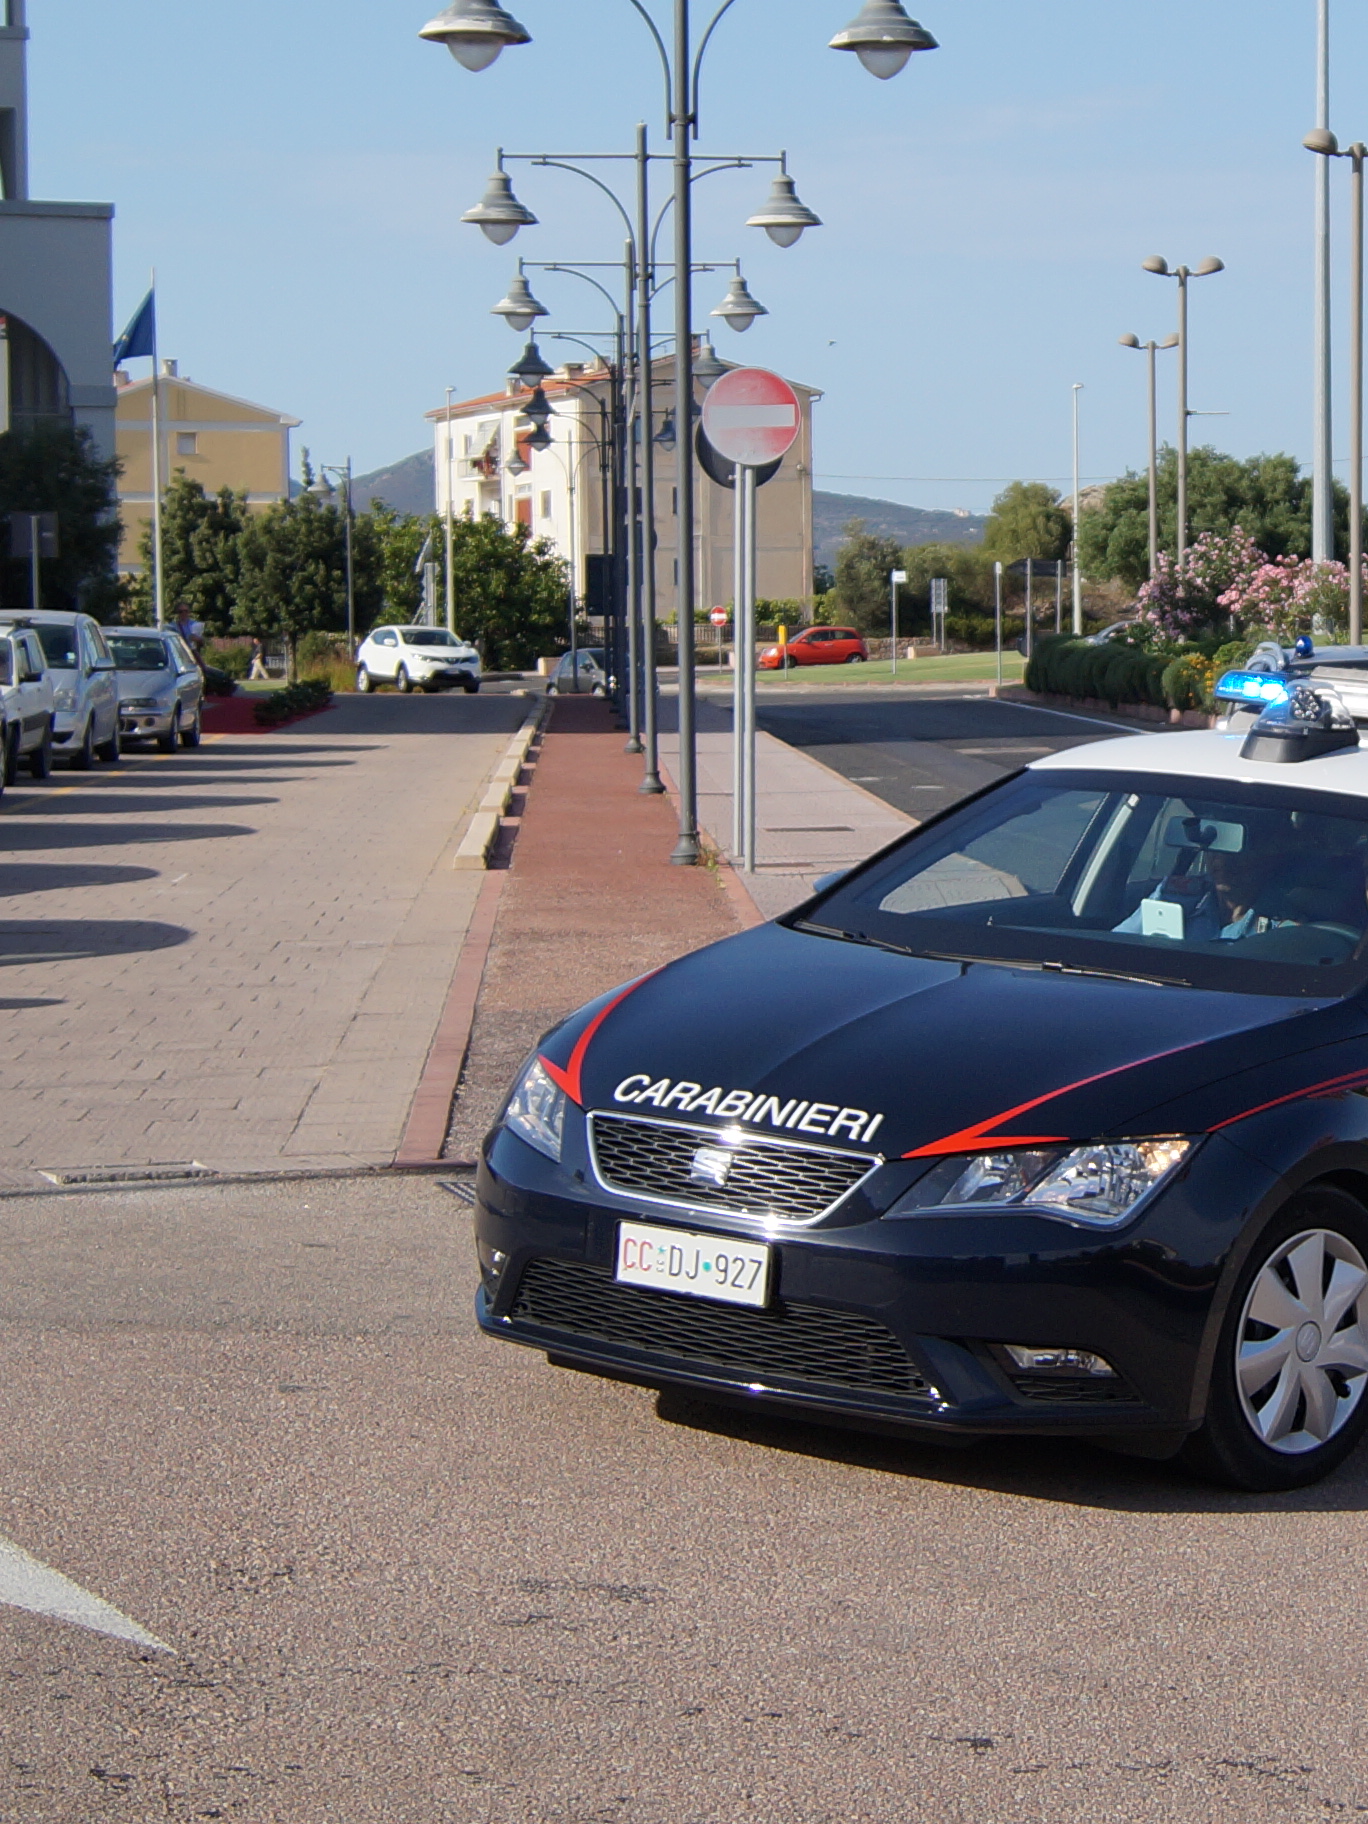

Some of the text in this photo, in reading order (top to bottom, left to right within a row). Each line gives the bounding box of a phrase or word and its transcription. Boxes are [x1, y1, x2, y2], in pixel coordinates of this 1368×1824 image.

[613, 1073, 884, 1143] CARABINIERI
[623, 1237, 764, 1291] CC DJ 927
